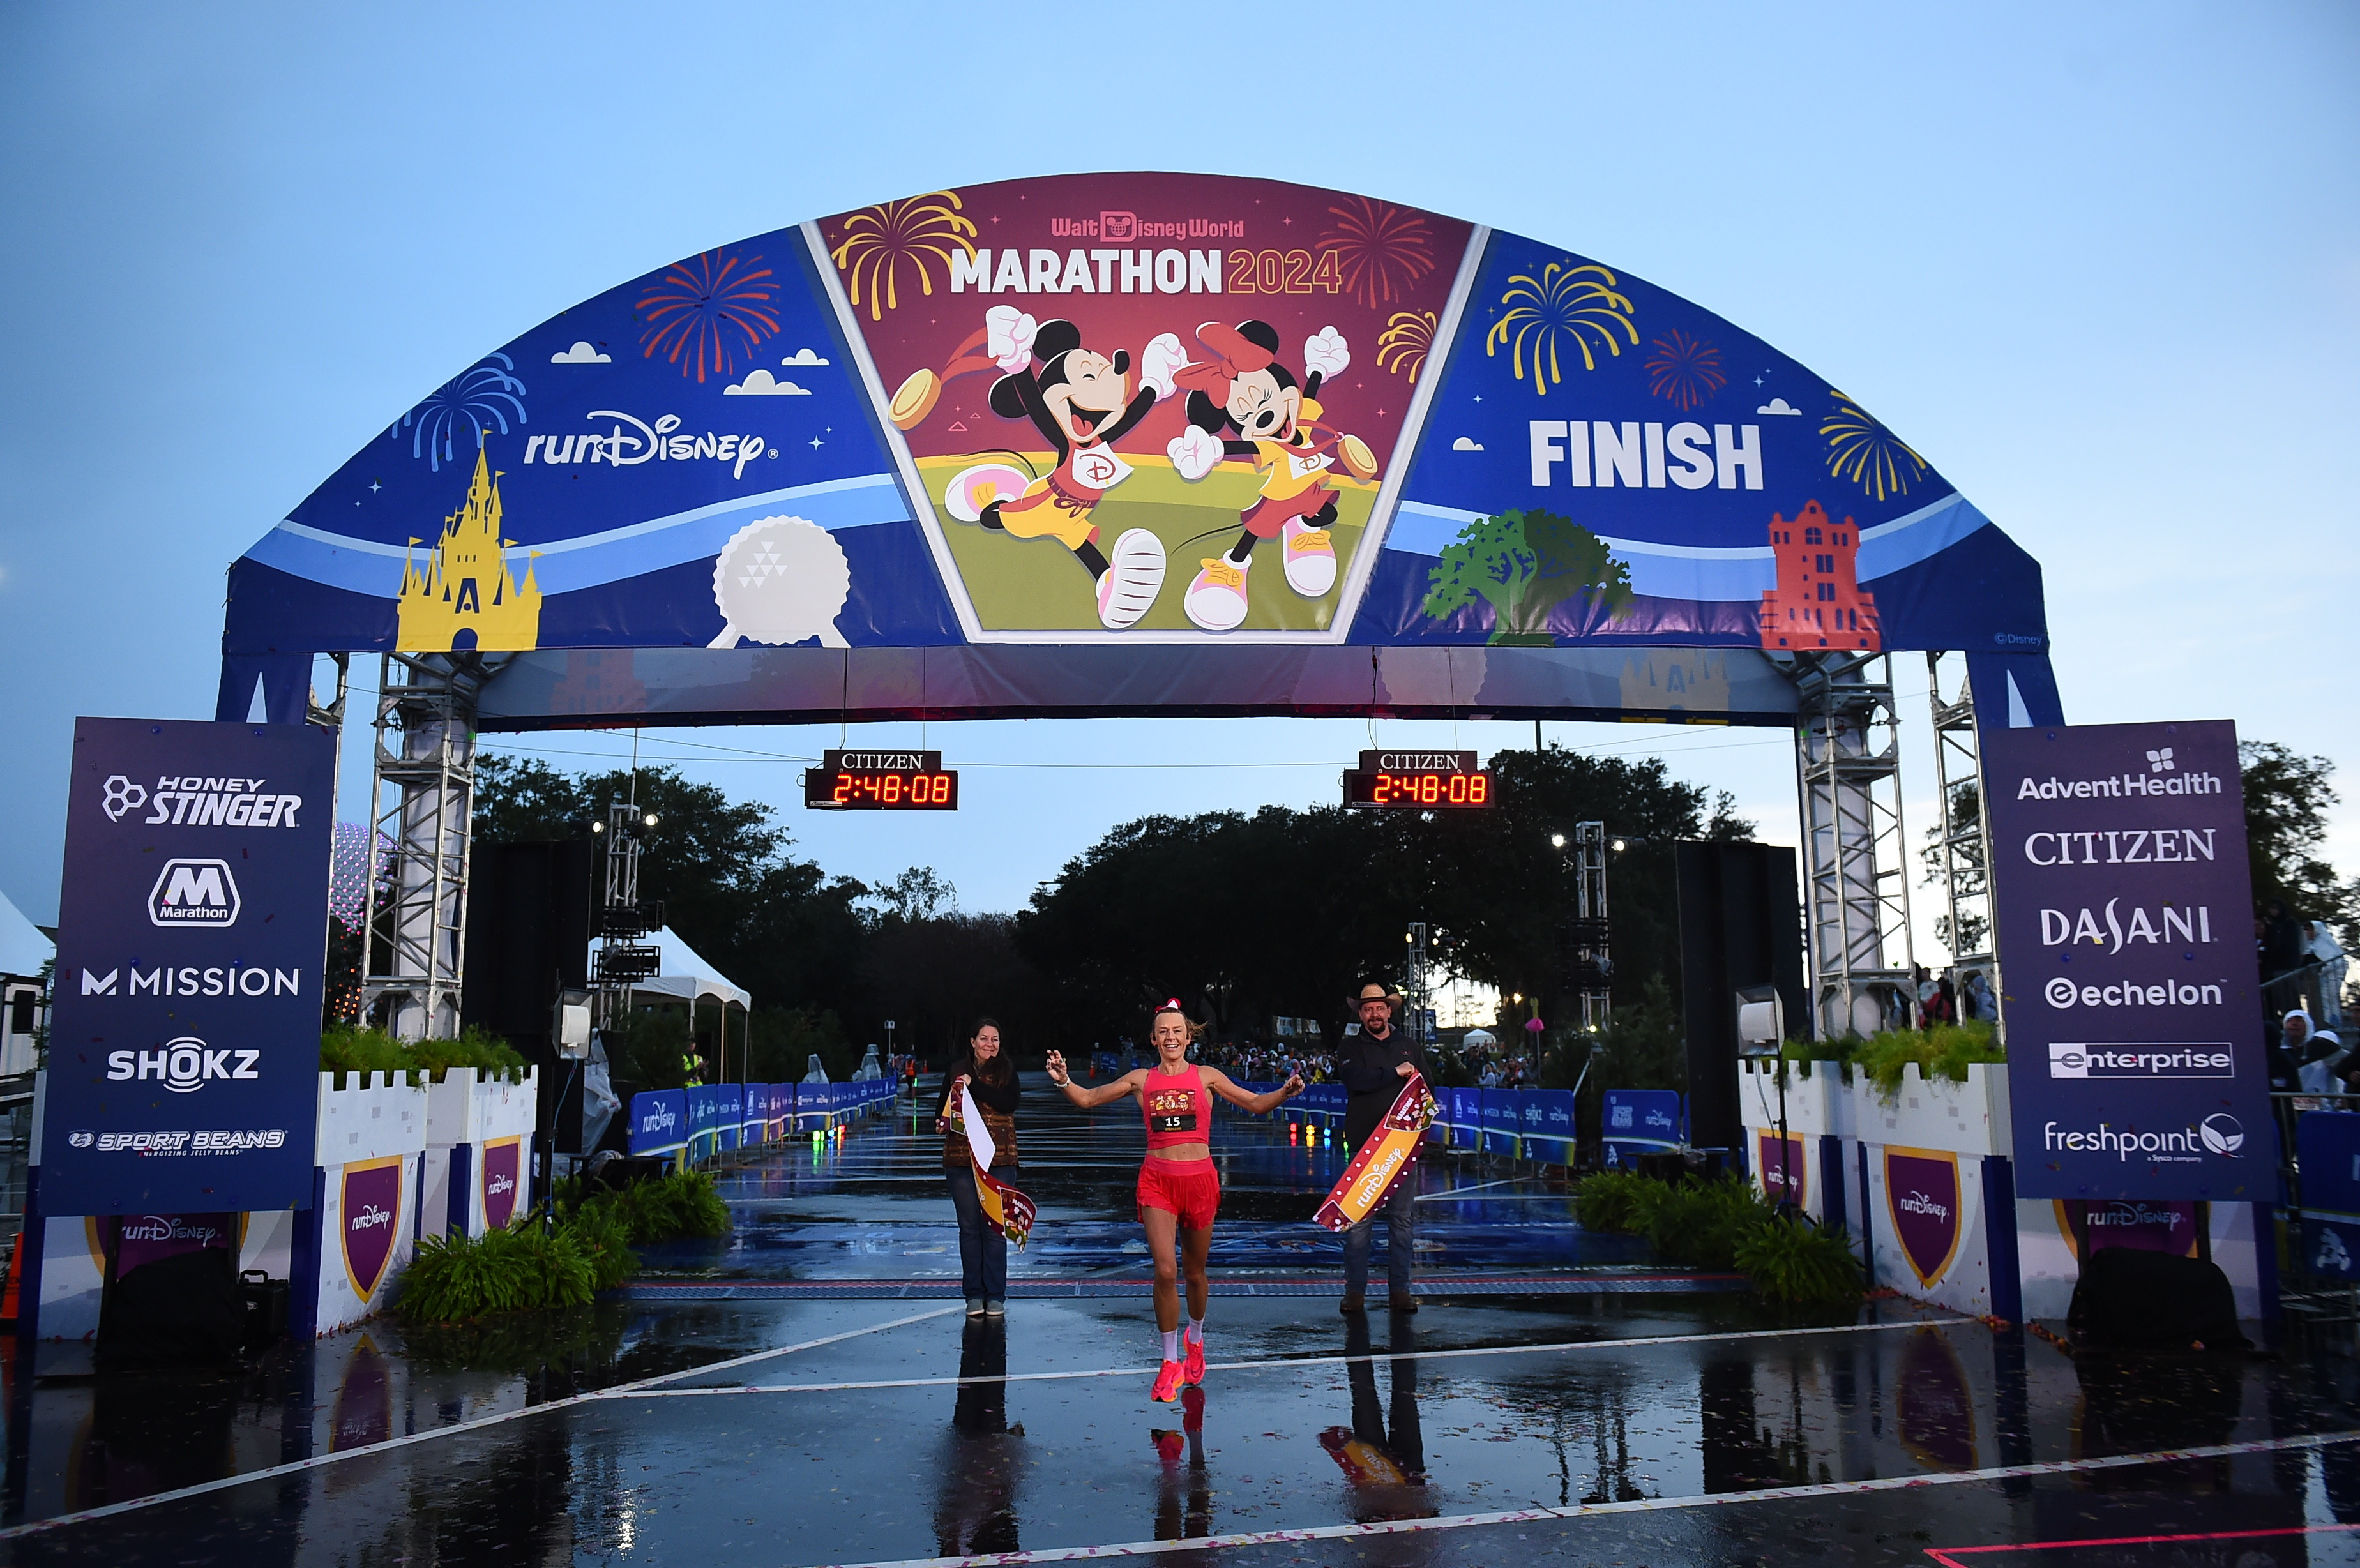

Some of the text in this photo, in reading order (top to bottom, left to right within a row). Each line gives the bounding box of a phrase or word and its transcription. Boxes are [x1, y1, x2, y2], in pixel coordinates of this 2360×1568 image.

[1051, 218, 1098, 238] Walt
[1188, 218, 1244, 238] World
[951, 248, 1342, 294] MARATHON 2024
[1529, 420, 1764, 490] FINISH
[842, 753, 923, 769] CITIZEN
[1380, 753, 1460, 770] CITIZEN
[156, 776, 266, 792] HONEY
[145, 792, 302, 828] STINGER
[2025, 829, 2216, 866] CITIZEN
[160, 906, 229, 919] Marathon
[2040, 896, 2211, 956] DASANI
[130, 967, 299, 996] MISSION
[2081, 979, 2223, 1006] echelon
[107, 1049, 260, 1080] SHOKZ
[2060, 1048, 2231, 1073] enterprise
[1165, 1117, 1181, 1126] 15
[97, 1131, 190, 1151] SPORT
[191, 1129, 285, 1148] BEANS
[2045, 1121, 2202, 1162] freshpoint
